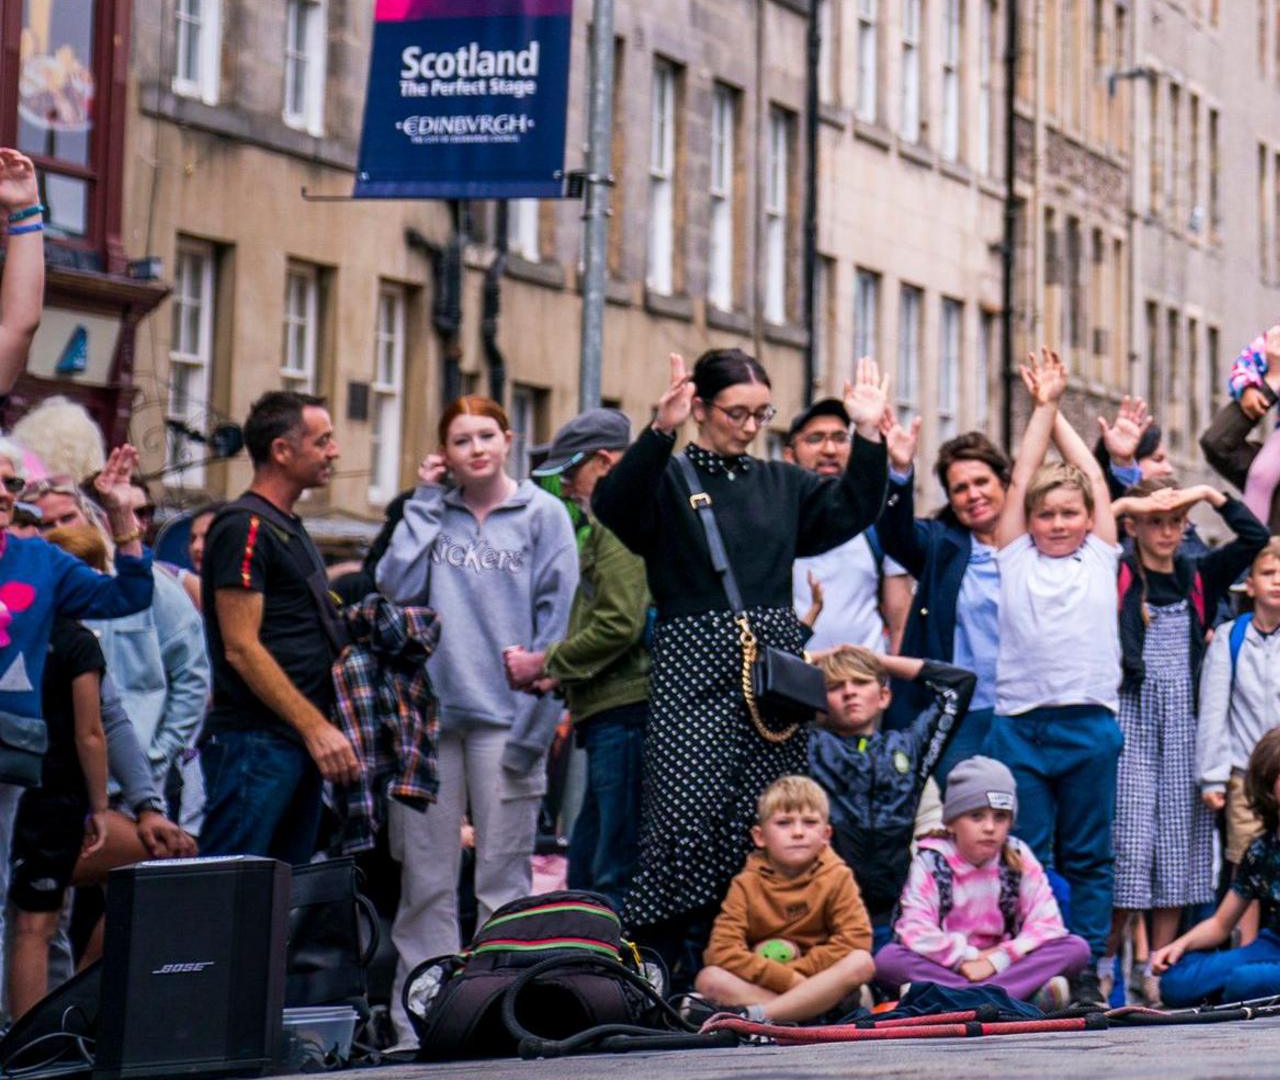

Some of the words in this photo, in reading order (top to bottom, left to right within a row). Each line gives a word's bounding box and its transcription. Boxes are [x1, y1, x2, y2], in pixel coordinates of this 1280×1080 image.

[400, 39, 539, 80] Scotland
[400, 79, 429, 98] The
[430, 77, 487, 97] Perfect
[488, 76, 537, 99] Stage
[152, 961, 215, 975] BOSE
